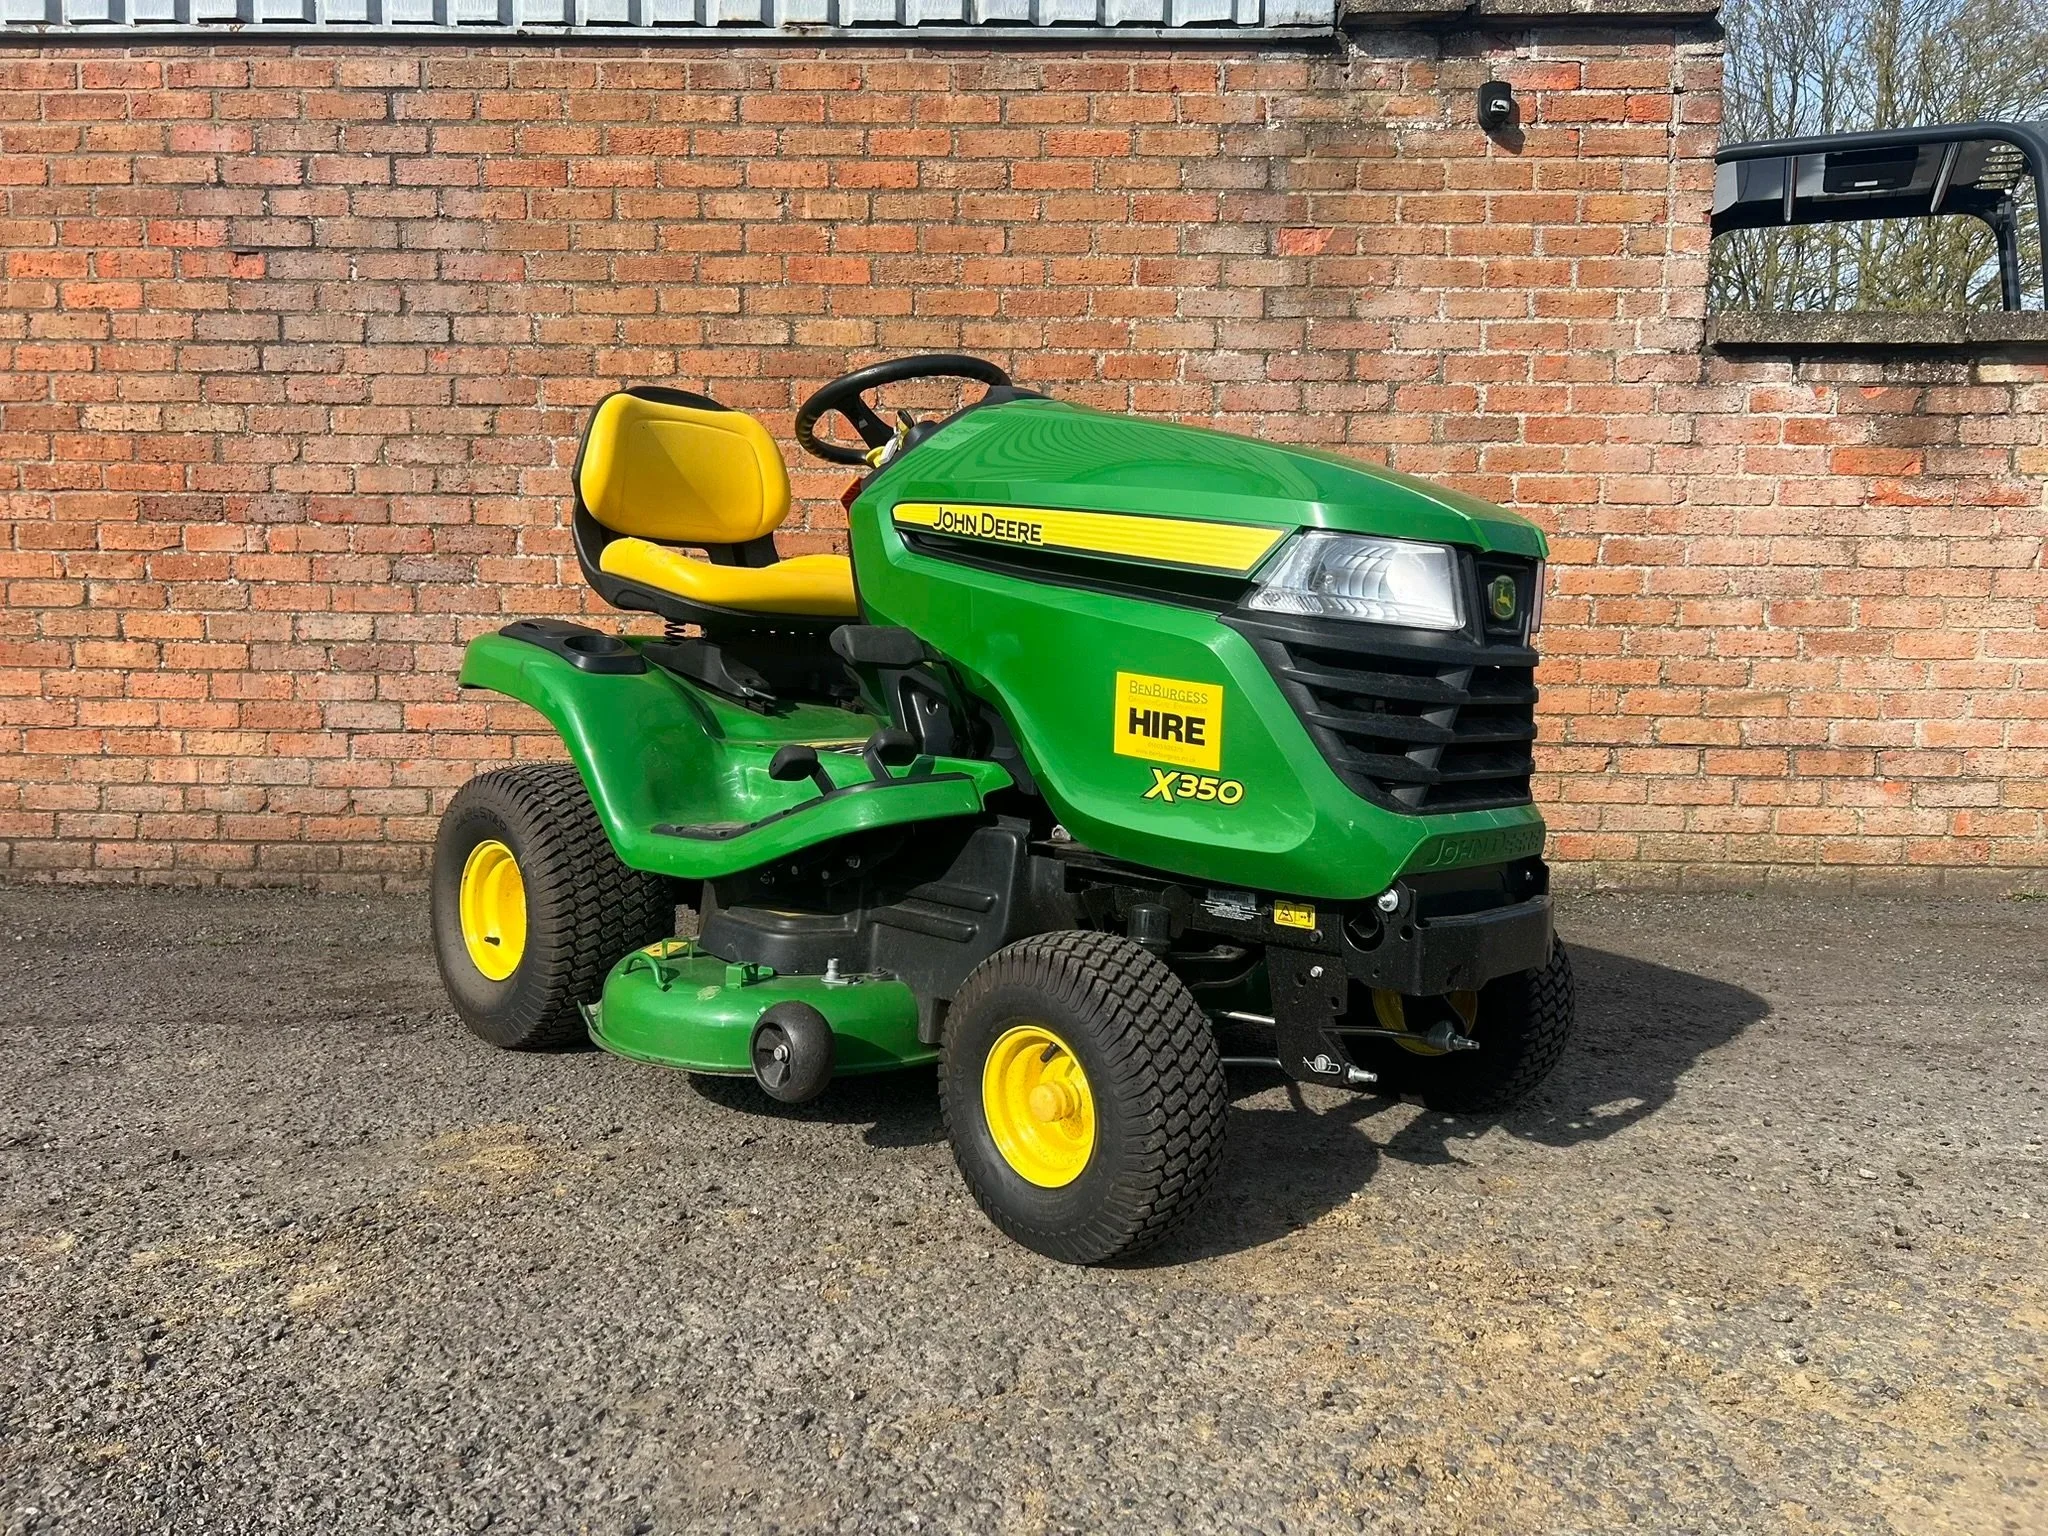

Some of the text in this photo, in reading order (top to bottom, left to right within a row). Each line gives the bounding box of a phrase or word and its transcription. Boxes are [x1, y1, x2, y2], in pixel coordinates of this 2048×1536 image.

[933, 506, 1043, 543] JOHN DEERE
[1128, 707, 1206, 746] HIRE
[1141, 767, 1245, 805] X350
[1424, 837, 1488, 867] JOHN
